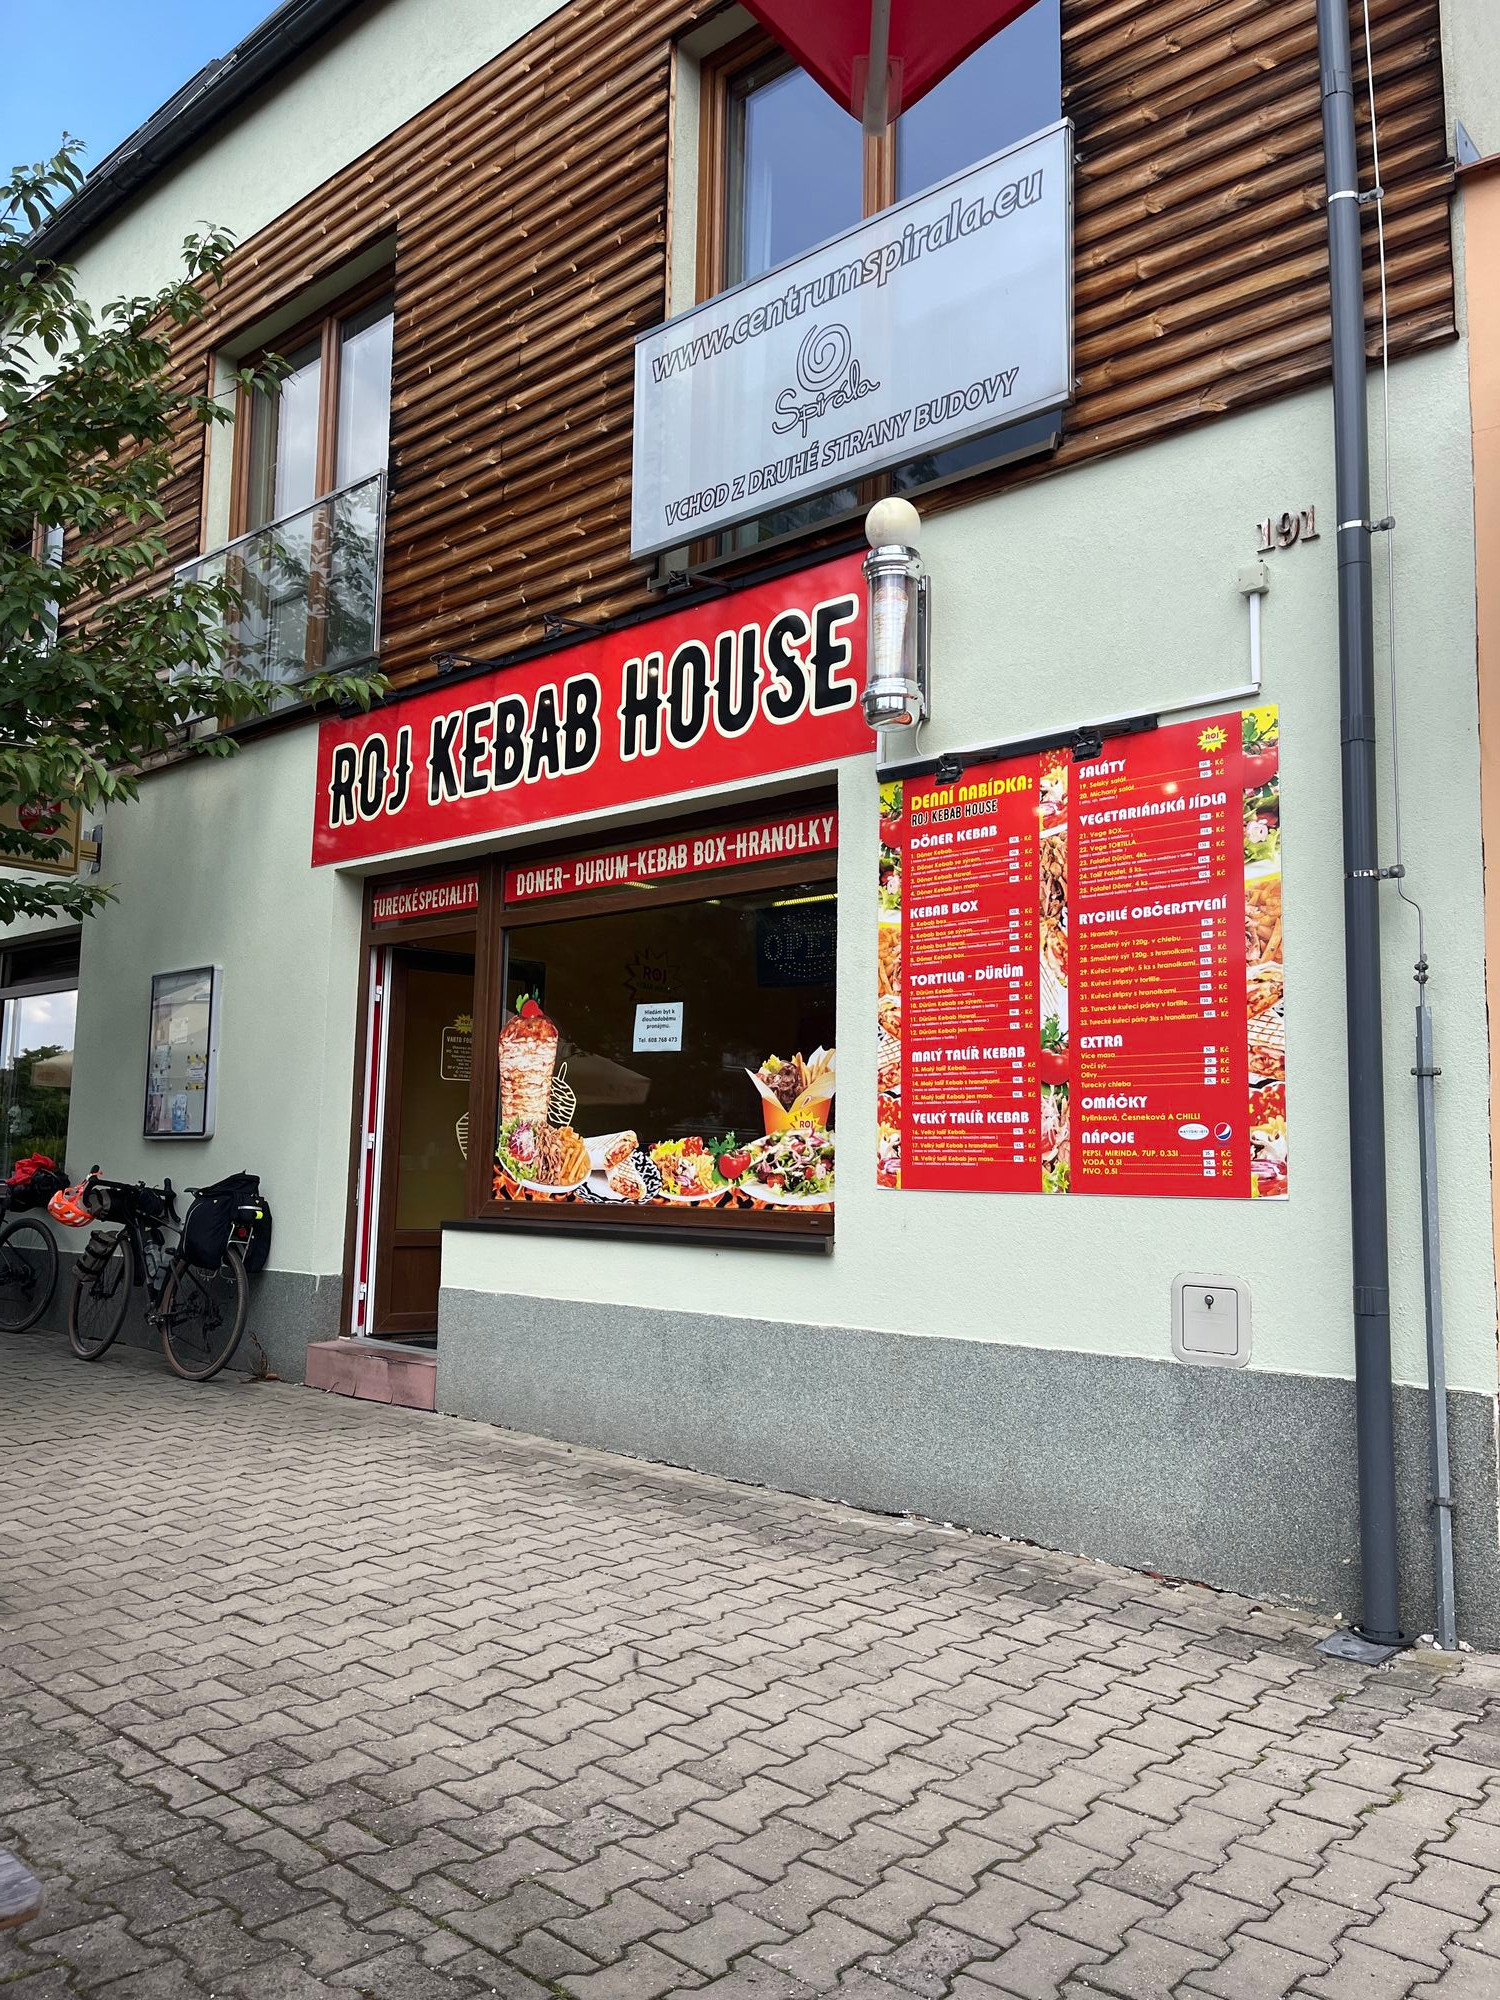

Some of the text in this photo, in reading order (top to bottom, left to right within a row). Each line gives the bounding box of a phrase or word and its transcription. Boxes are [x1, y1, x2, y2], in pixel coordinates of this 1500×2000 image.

[652, 169, 1044, 382] www.centrumspirala.eu
[664, 367, 1019, 526] VCHOD Z DRUHÉ STRANY BUDOVY
[1256, 504, 1320, 555] 191
[329, 593, 859, 829] ROJ KEBAB HOUSE
[1079, 758, 1126, 779] SALÁTY
[911, 775, 1033, 811] DENNÍ NABÍDKA:
[911, 799, 998, 827] ROJ KEBAB HOUSE
[1079, 796, 1185, 827] VEGETARIÁNSKÁ
[1188, 792, 1227, 810] JÍDLA
[910, 825, 998, 850] DÖNER KEBAB
[1108, 827, 1122, 835] BOX
[910, 900, 979, 919] KEBAB BOX
[1079, 894, 1227, 925] RYCHLÉ OBČERSTVENÍ
[1090, 930, 1118, 938] Hranolky
[1157, 935, 1181, 943] chlebu
[910, 971, 965, 986] TORTILLA
[975, 963, 1024, 981] DÜRÜM
[1080, 1034, 1123, 1049] EXTRA
[911, 1046, 1026, 1063] MALÝ TALÍŘ KEBAB
[1108, 1080, 1131, 1088] chleba
[1081, 1092, 1148, 1109] OMÁČKY
[799, 1120, 814, 1128] ROJ
[912, 1109, 1030, 1124] VELKÝ TALÍŘ KEBAB
[1081, 1128, 1135, 1144] NÁPOJE
